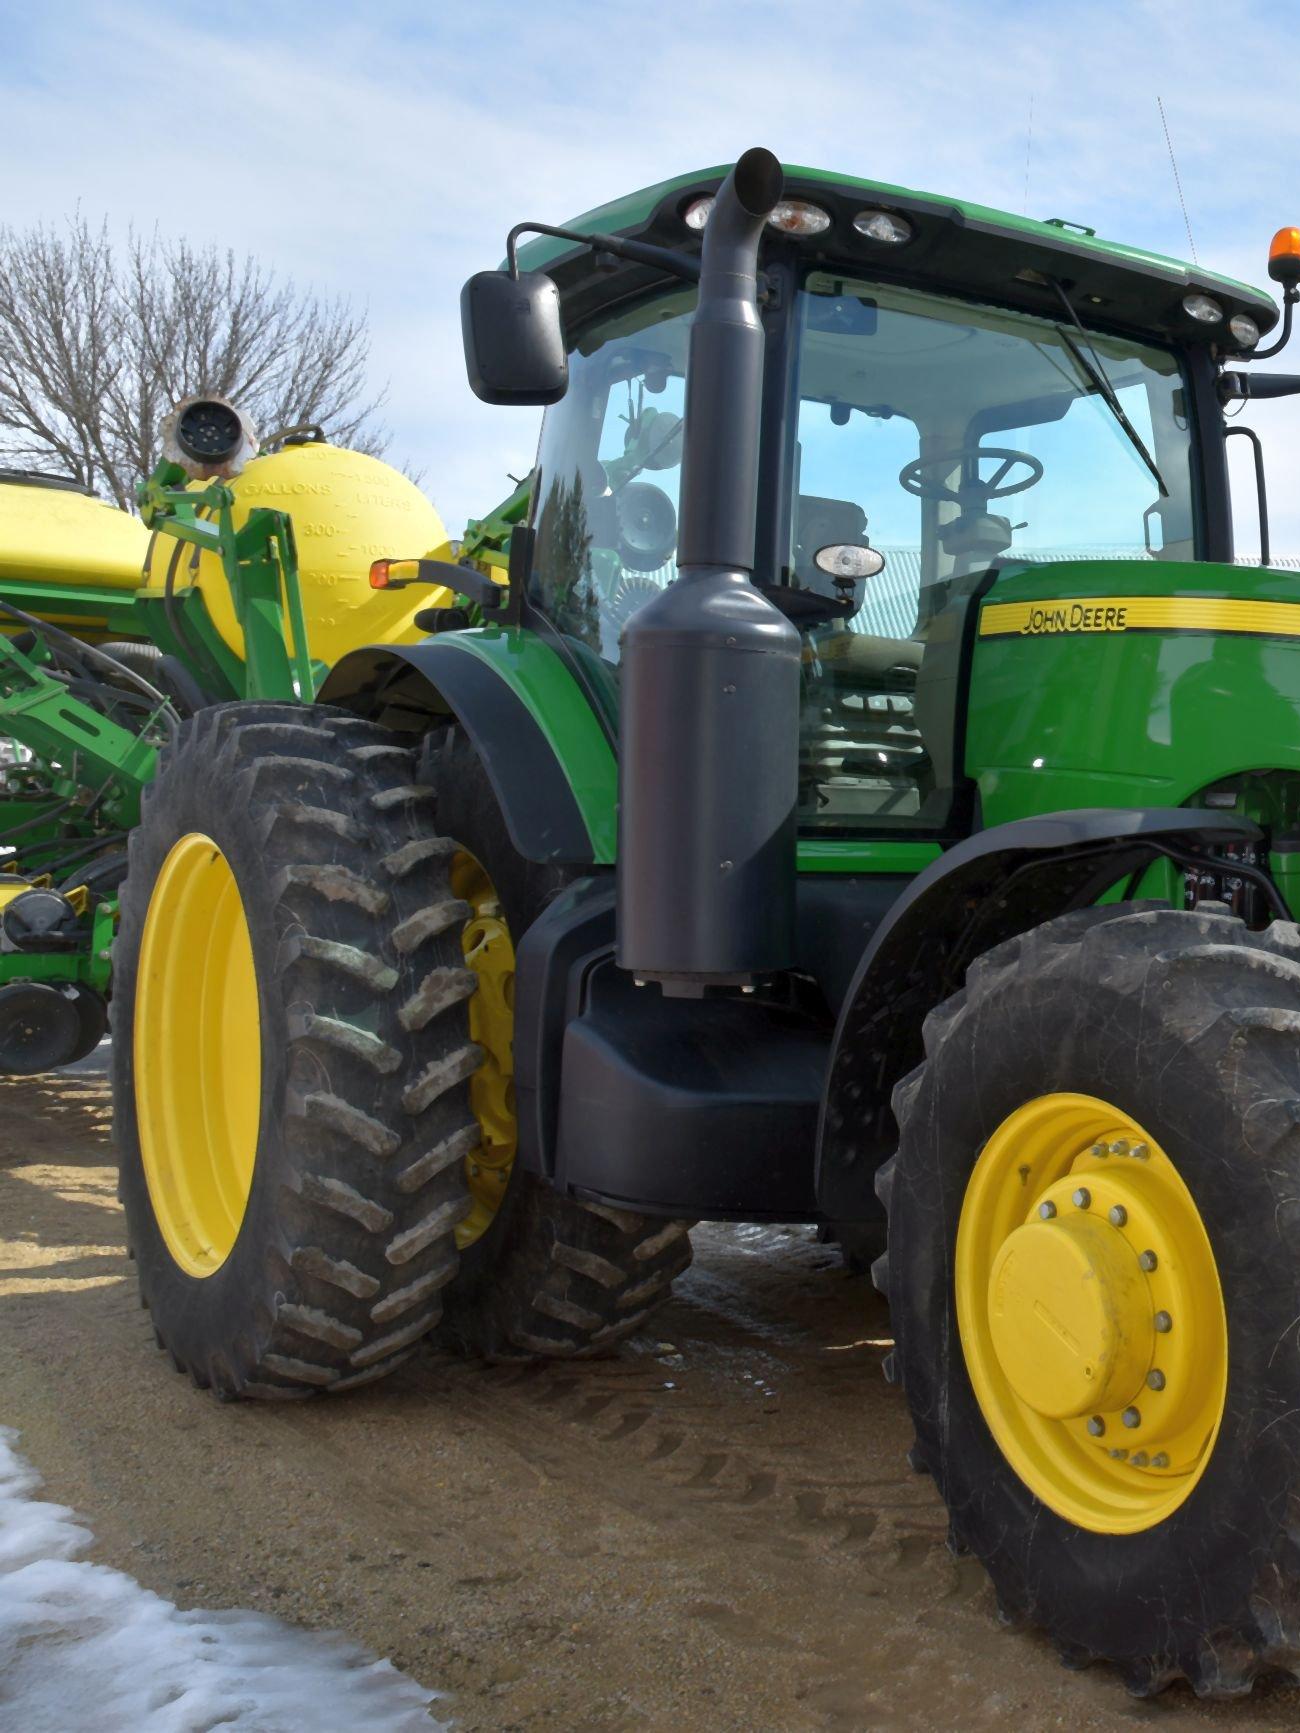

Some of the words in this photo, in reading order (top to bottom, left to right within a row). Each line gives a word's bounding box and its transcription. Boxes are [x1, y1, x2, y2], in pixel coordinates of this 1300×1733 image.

[243, 482, 334, 497] GALLONS
[304, 523, 336, 538] 300
[1022, 606, 1067, 631] JOHN
[1069, 603, 1128, 629] DEERE
